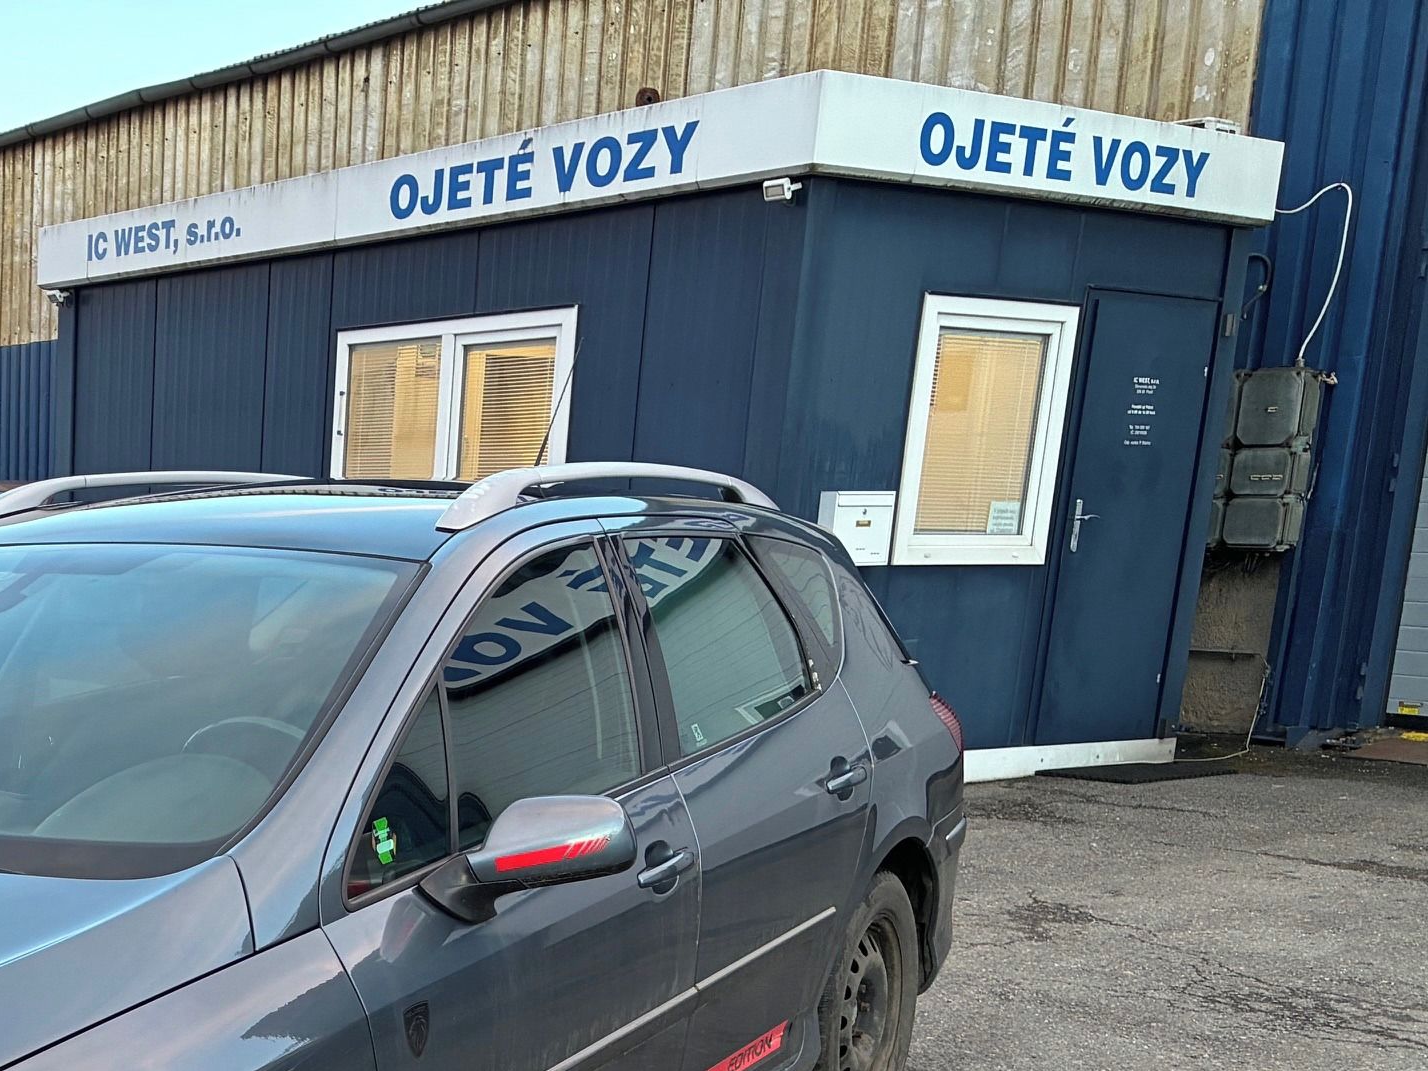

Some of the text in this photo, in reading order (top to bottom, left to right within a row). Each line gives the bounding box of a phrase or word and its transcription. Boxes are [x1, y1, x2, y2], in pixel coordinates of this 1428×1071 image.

[389, 120, 700, 220] OJETÉ VOZY
[920, 111, 1211, 198] OJETÉ VOZY
[87, 216, 241, 261] IC WEST, s.r.o.
